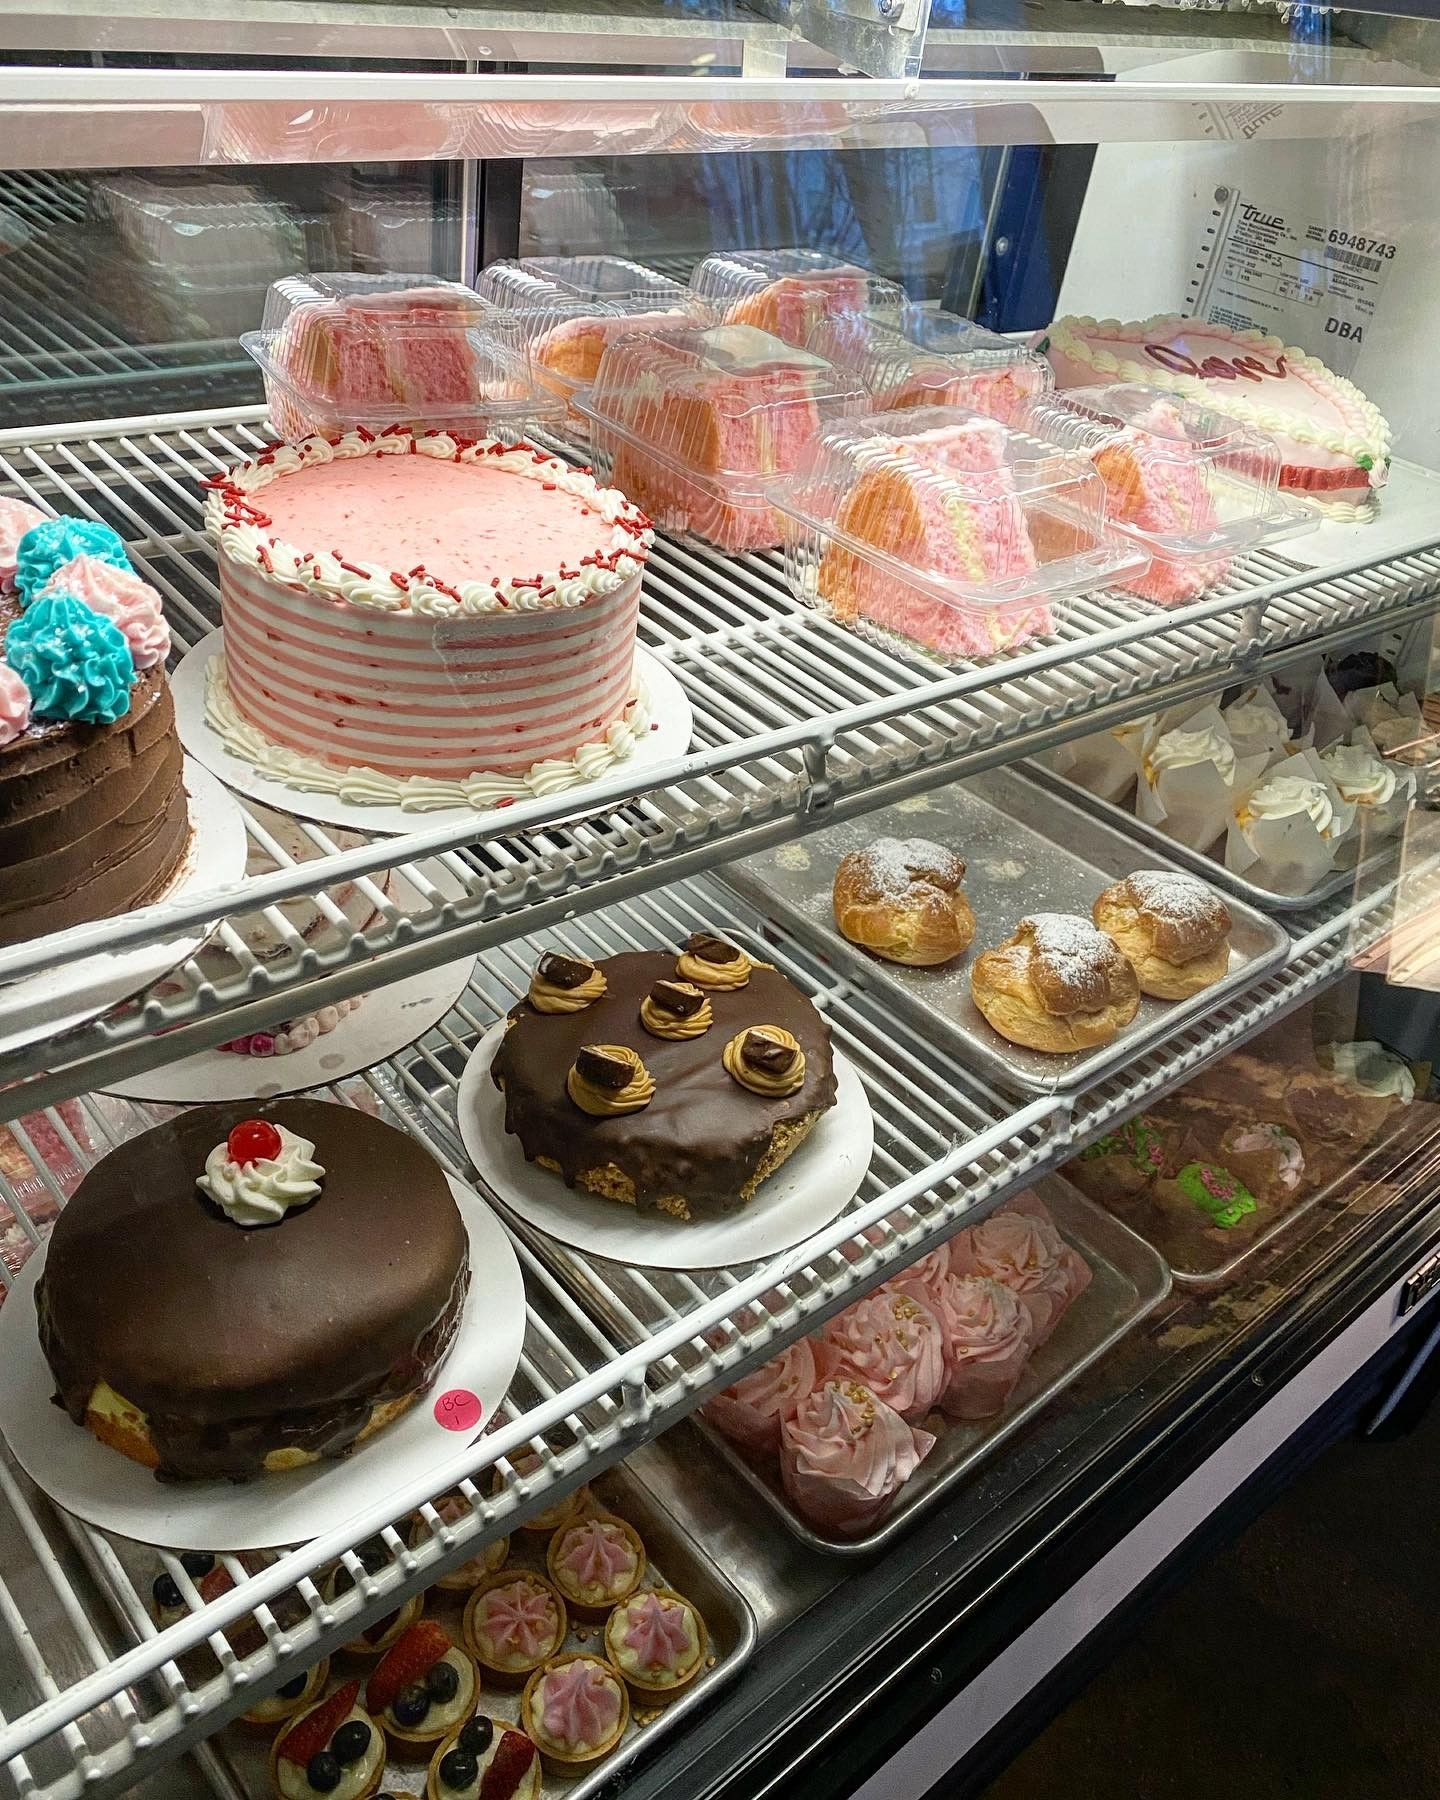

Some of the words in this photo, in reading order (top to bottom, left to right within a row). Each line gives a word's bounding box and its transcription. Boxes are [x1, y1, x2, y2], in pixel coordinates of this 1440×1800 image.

[1328, 229, 1396, 259] 6948743
[1324, 317, 1363, 343] DBA
[442, 1395, 471, 1411] BC
